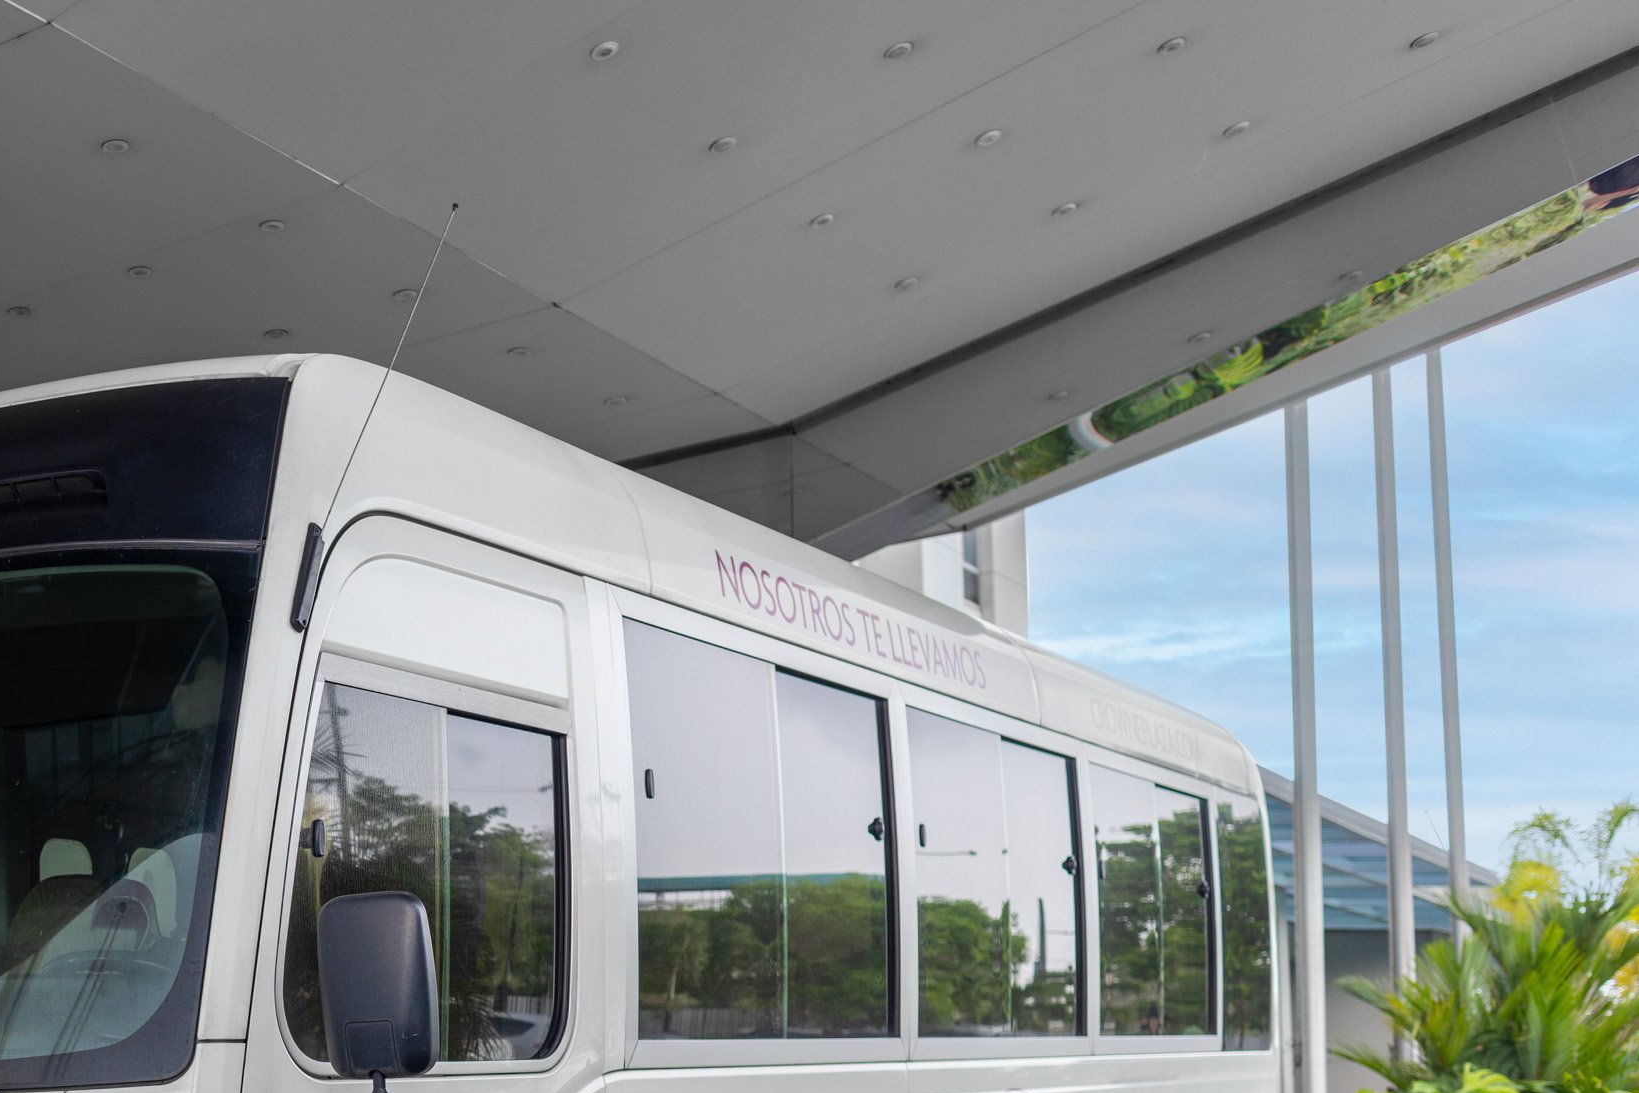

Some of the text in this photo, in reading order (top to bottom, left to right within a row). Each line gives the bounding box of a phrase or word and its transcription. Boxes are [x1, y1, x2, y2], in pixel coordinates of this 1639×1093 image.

[715, 549, 987, 690] NOSOTROS TE LLEVAMOS
